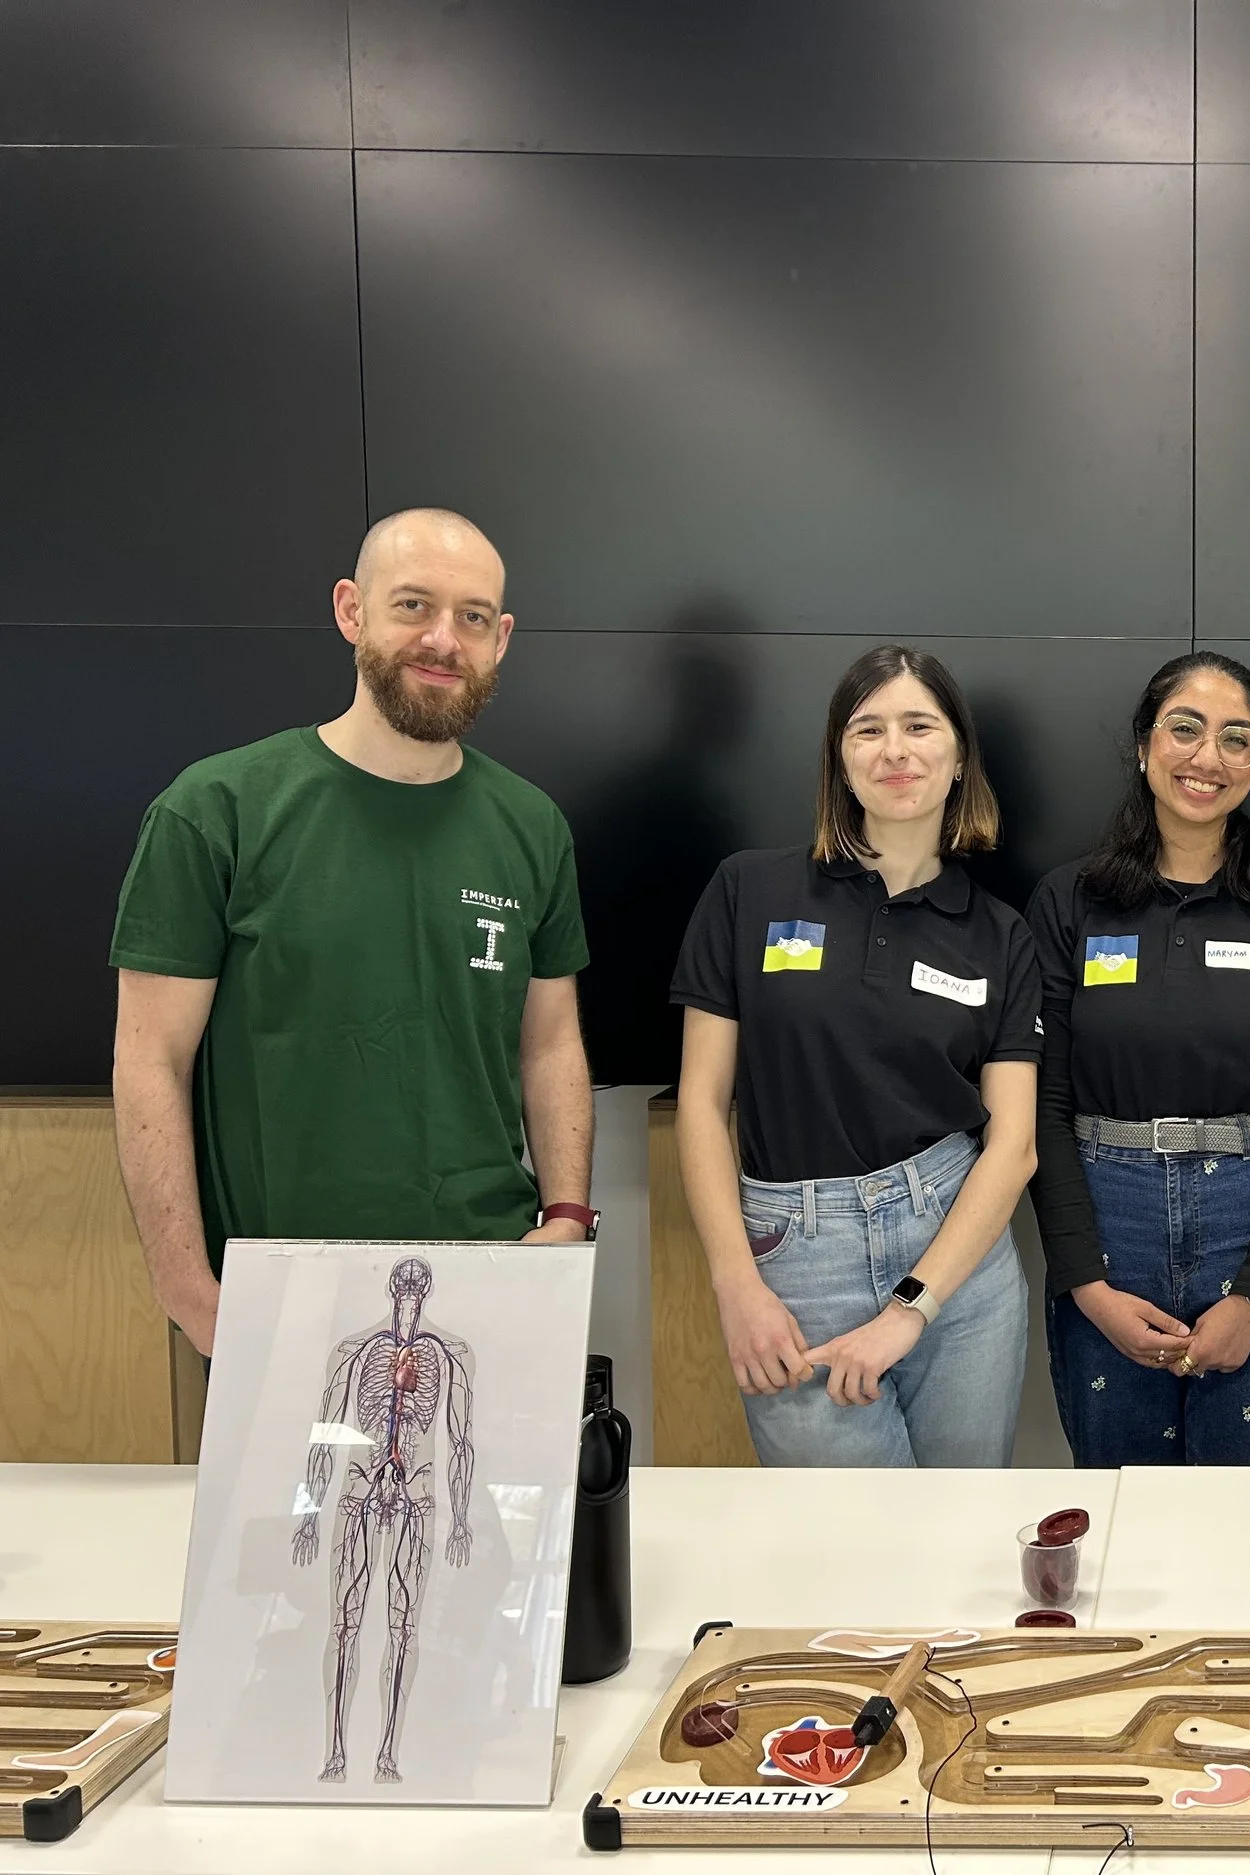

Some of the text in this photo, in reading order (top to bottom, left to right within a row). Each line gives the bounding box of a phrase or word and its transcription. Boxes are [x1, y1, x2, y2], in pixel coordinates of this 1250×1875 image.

[461, 889, 520, 909] IMPERIAL
[1207, 949, 1247, 958] MARYAM
[919, 969, 970, 994] IOANA
[641, 1791, 835, 1806] UNHEALTHY
